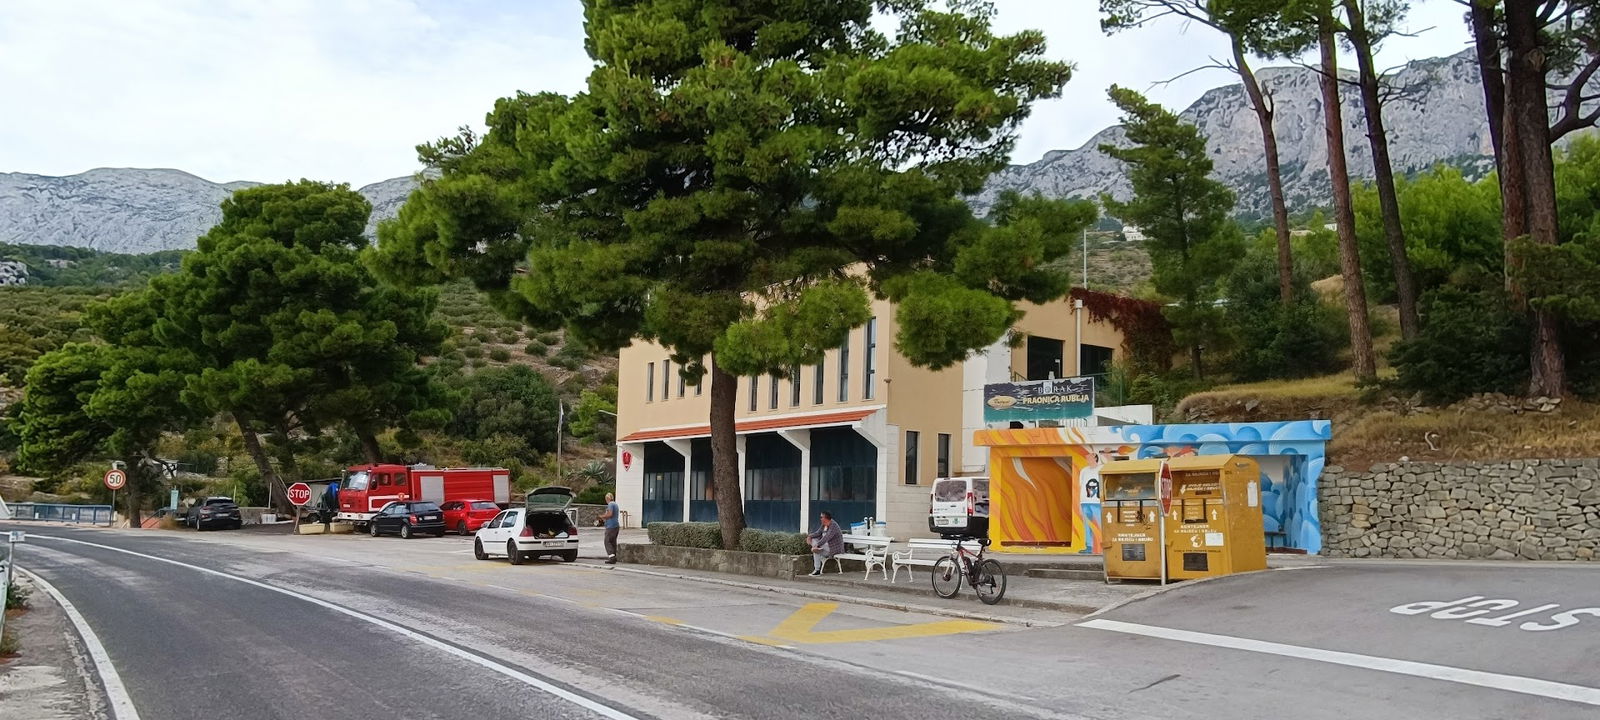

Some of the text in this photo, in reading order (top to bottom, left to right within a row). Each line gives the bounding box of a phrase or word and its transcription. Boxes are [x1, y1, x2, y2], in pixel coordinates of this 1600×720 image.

[1022, 395, 1060, 405] PRAONICA
[109, 474, 121, 484] 50
[289, 489, 310, 499] STOP
[1389, 596, 1600, 631] STOP
